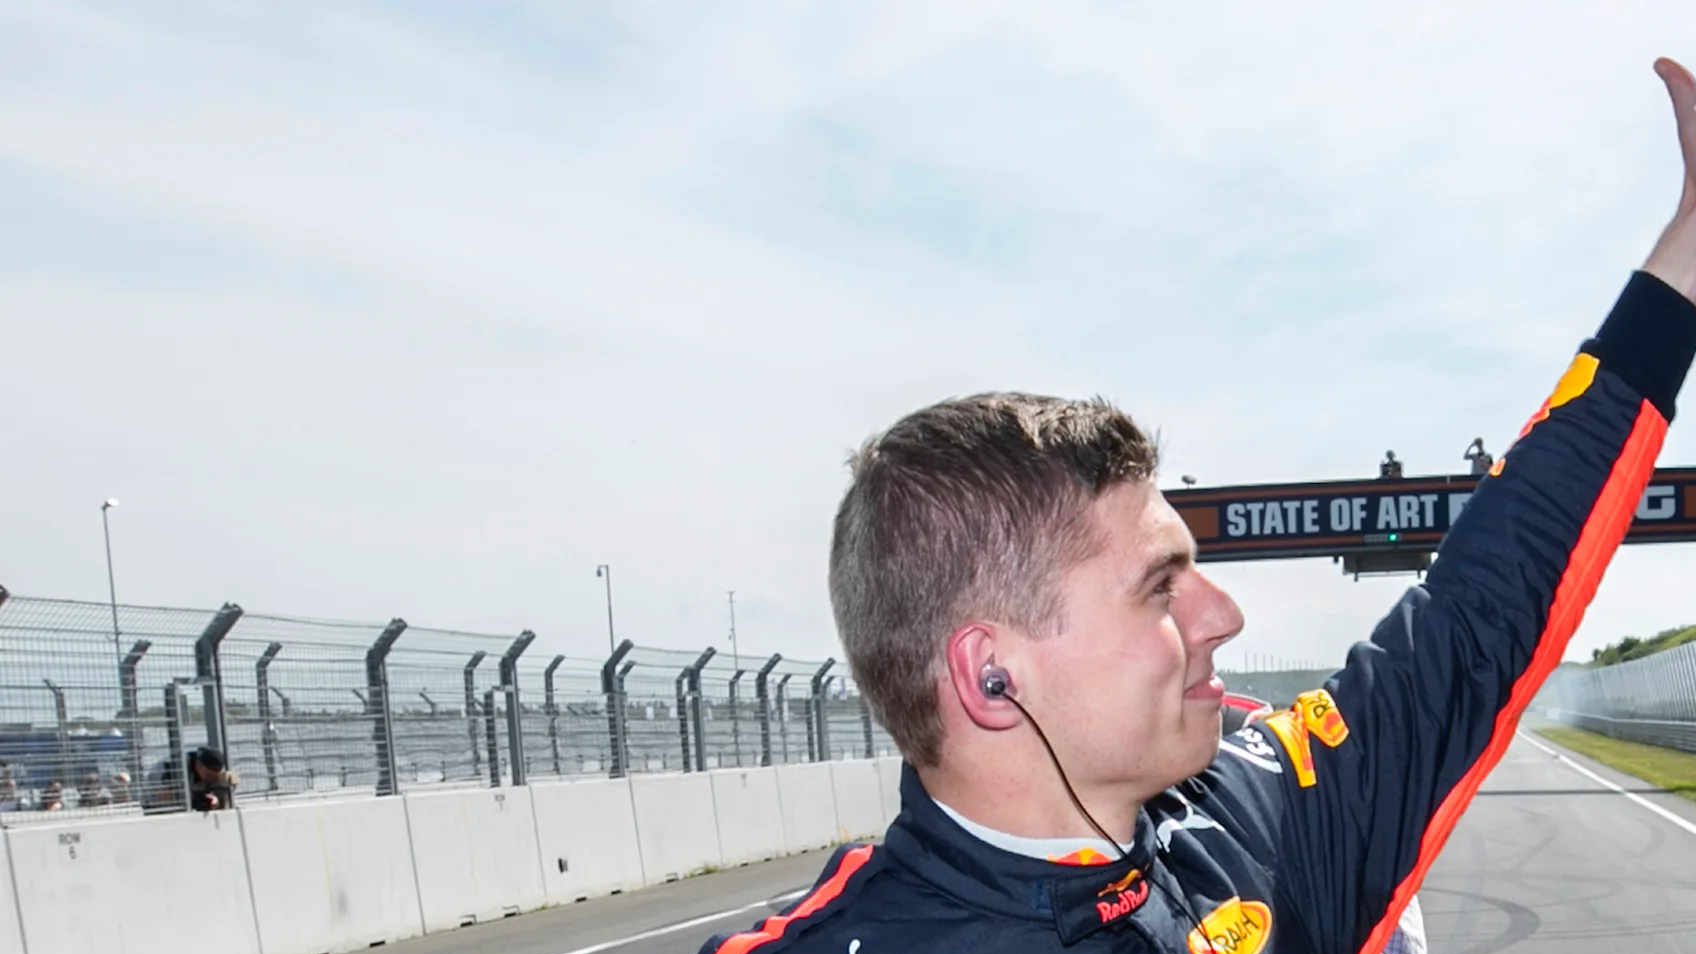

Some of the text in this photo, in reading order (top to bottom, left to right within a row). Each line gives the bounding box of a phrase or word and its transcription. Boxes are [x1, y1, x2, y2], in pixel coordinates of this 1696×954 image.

[1226, 500, 1320, 537] STATE
[1330, 497, 1367, 532] OF
[1376, 494, 1438, 530] ART
